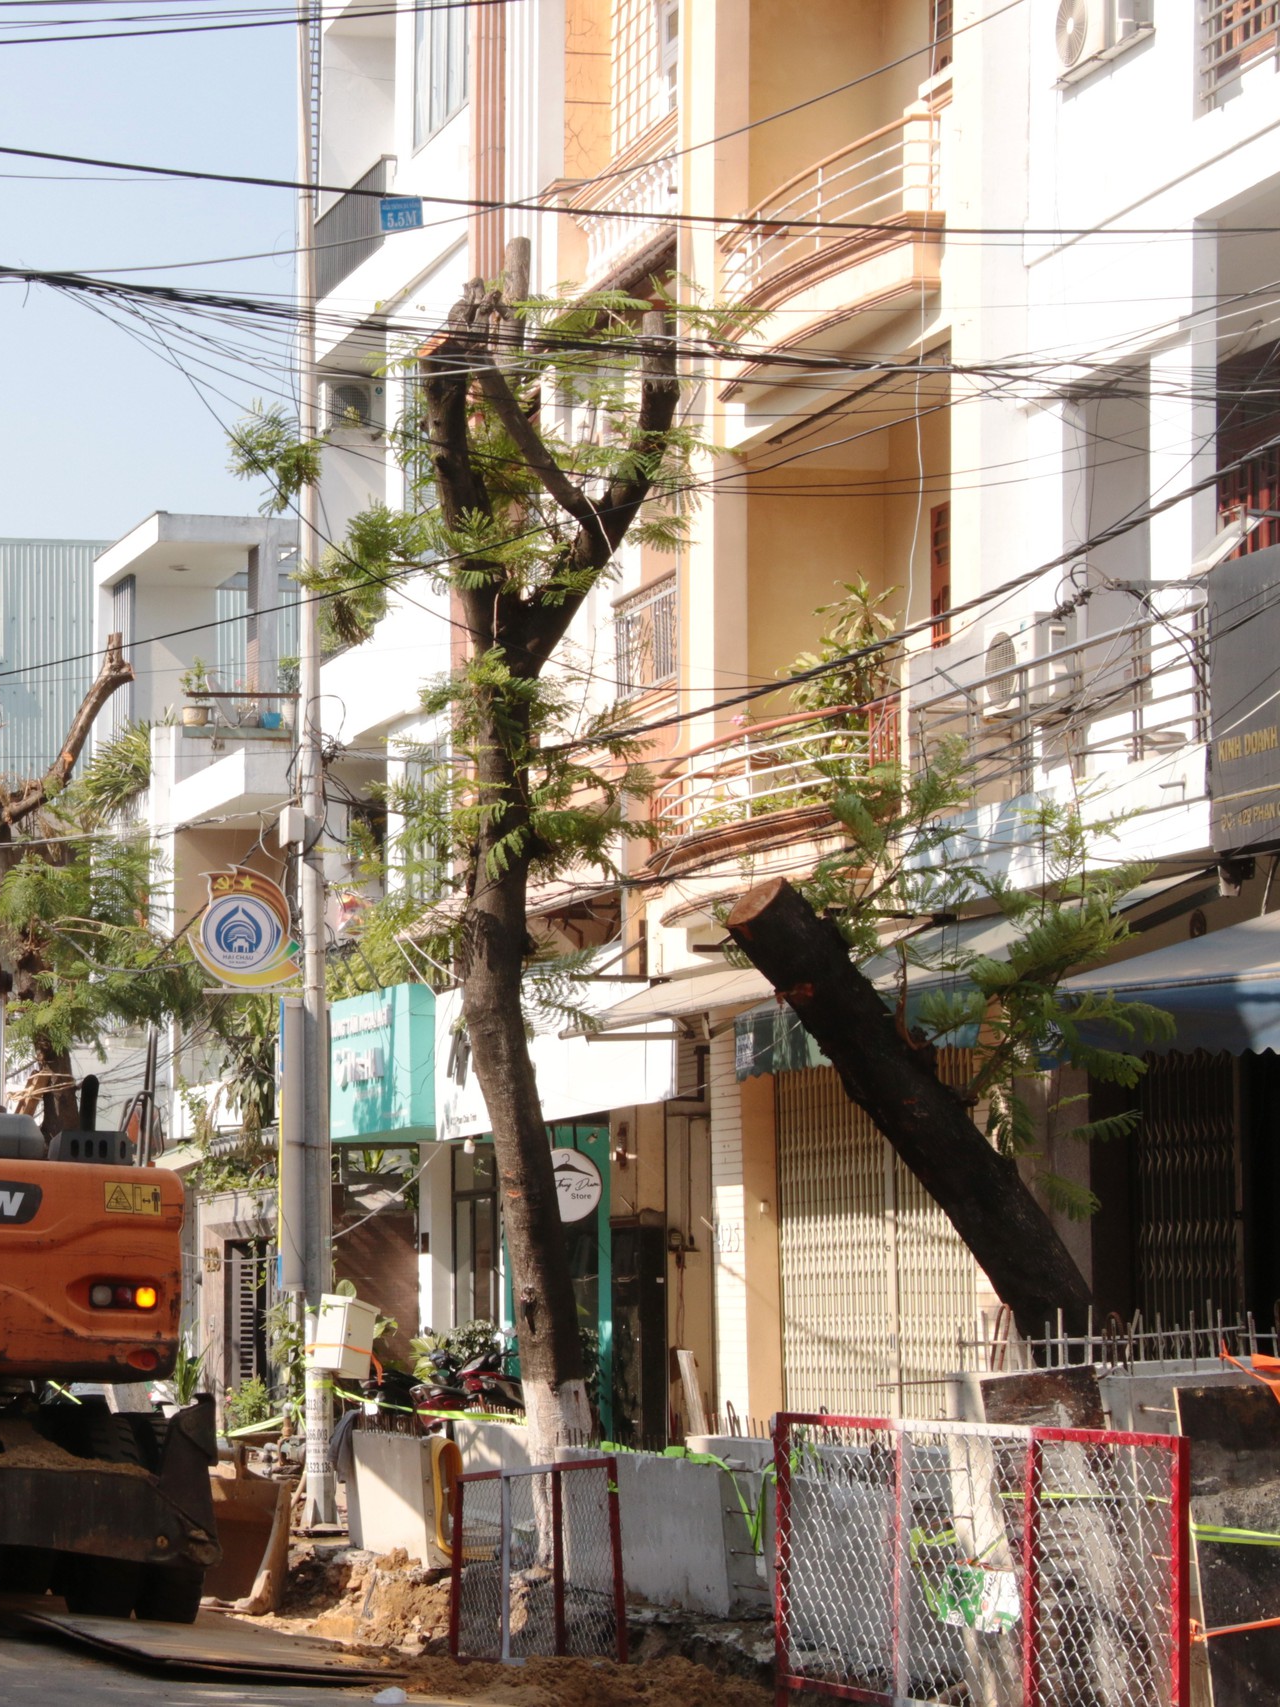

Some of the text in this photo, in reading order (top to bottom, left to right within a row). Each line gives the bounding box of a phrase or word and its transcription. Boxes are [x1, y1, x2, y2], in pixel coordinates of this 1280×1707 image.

[387, 210, 417, 228] 5.5M
[1218, 725, 1278, 762] KINH DOANH
[1253, 803, 1276, 824] PHAN
[571, 1192, 592, 1200] Store
